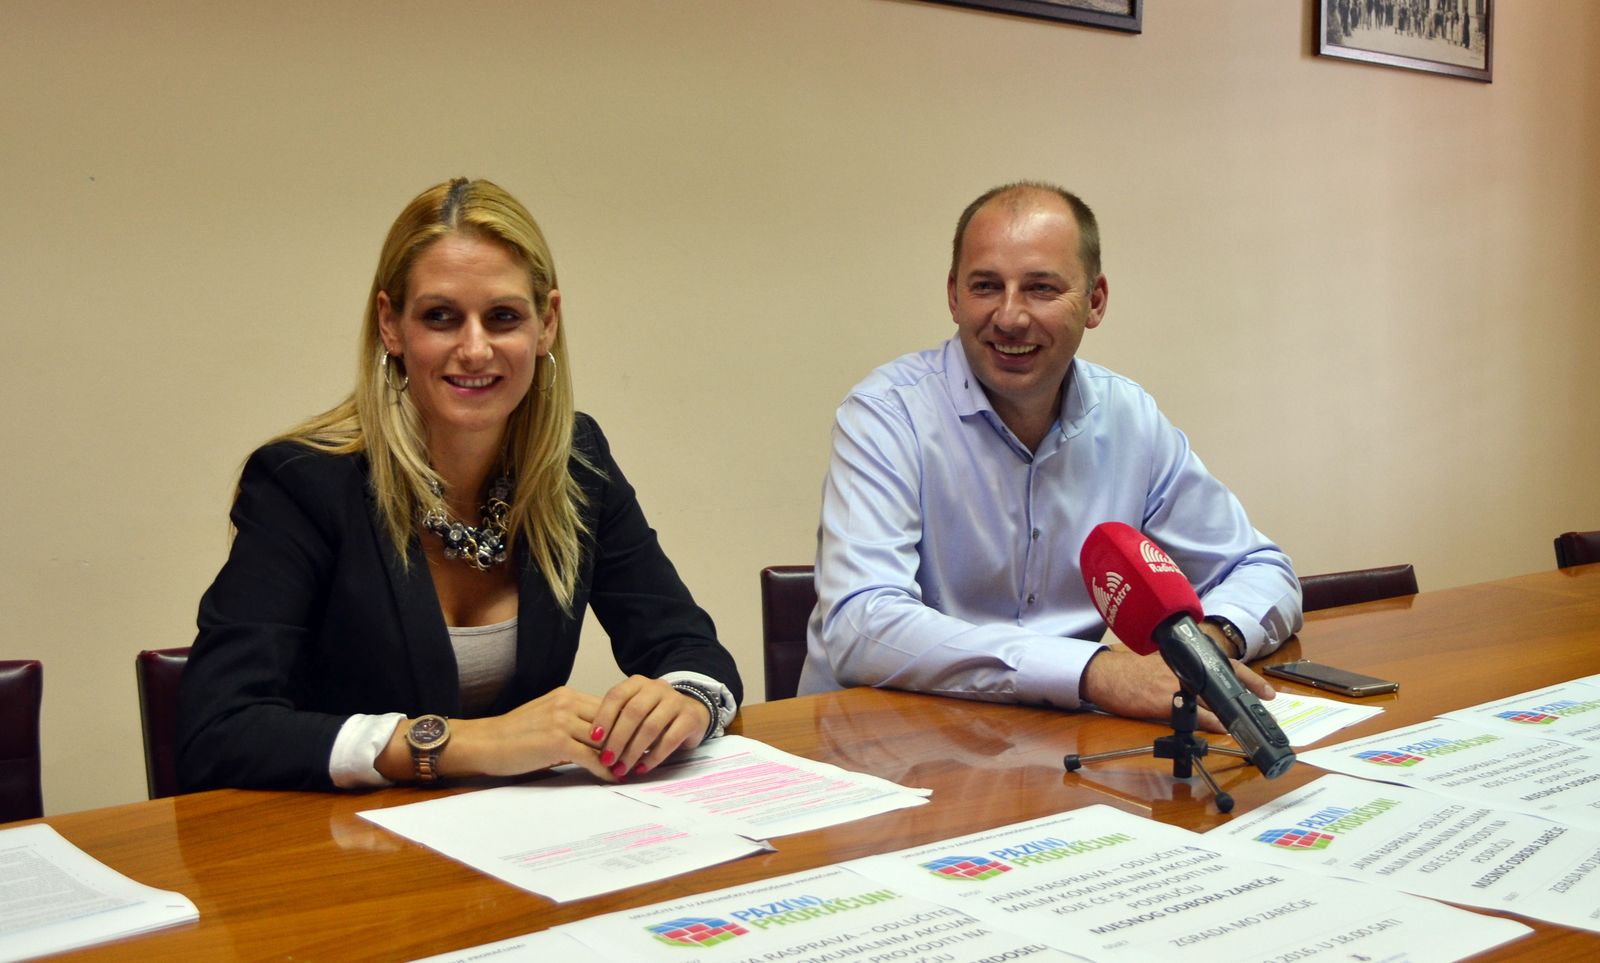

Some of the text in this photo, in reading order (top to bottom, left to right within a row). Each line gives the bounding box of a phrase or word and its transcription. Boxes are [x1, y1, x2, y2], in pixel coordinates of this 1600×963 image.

[985, 888, 1038, 904] JAVNA
[1034, 869, 1112, 891] RASPRAVA
[1051, 901, 1093, 915] KOJE
[1203, 864, 1229, 873] NA
[1002, 895, 1058, 913] MALIM
[1089, 910, 1166, 934] MJESNOG
[1163, 893, 1230, 914] ODBORA
[962, 928, 992, 939] NA
[1168, 925, 1233, 947] ZGRADA
[1229, 916, 1261, 930] MO
[1367, 918, 1404, 931] SATI
[763, 933, 859, 961] RASPRAVA
[800, 934, 914, 963] OMUNALNIM
